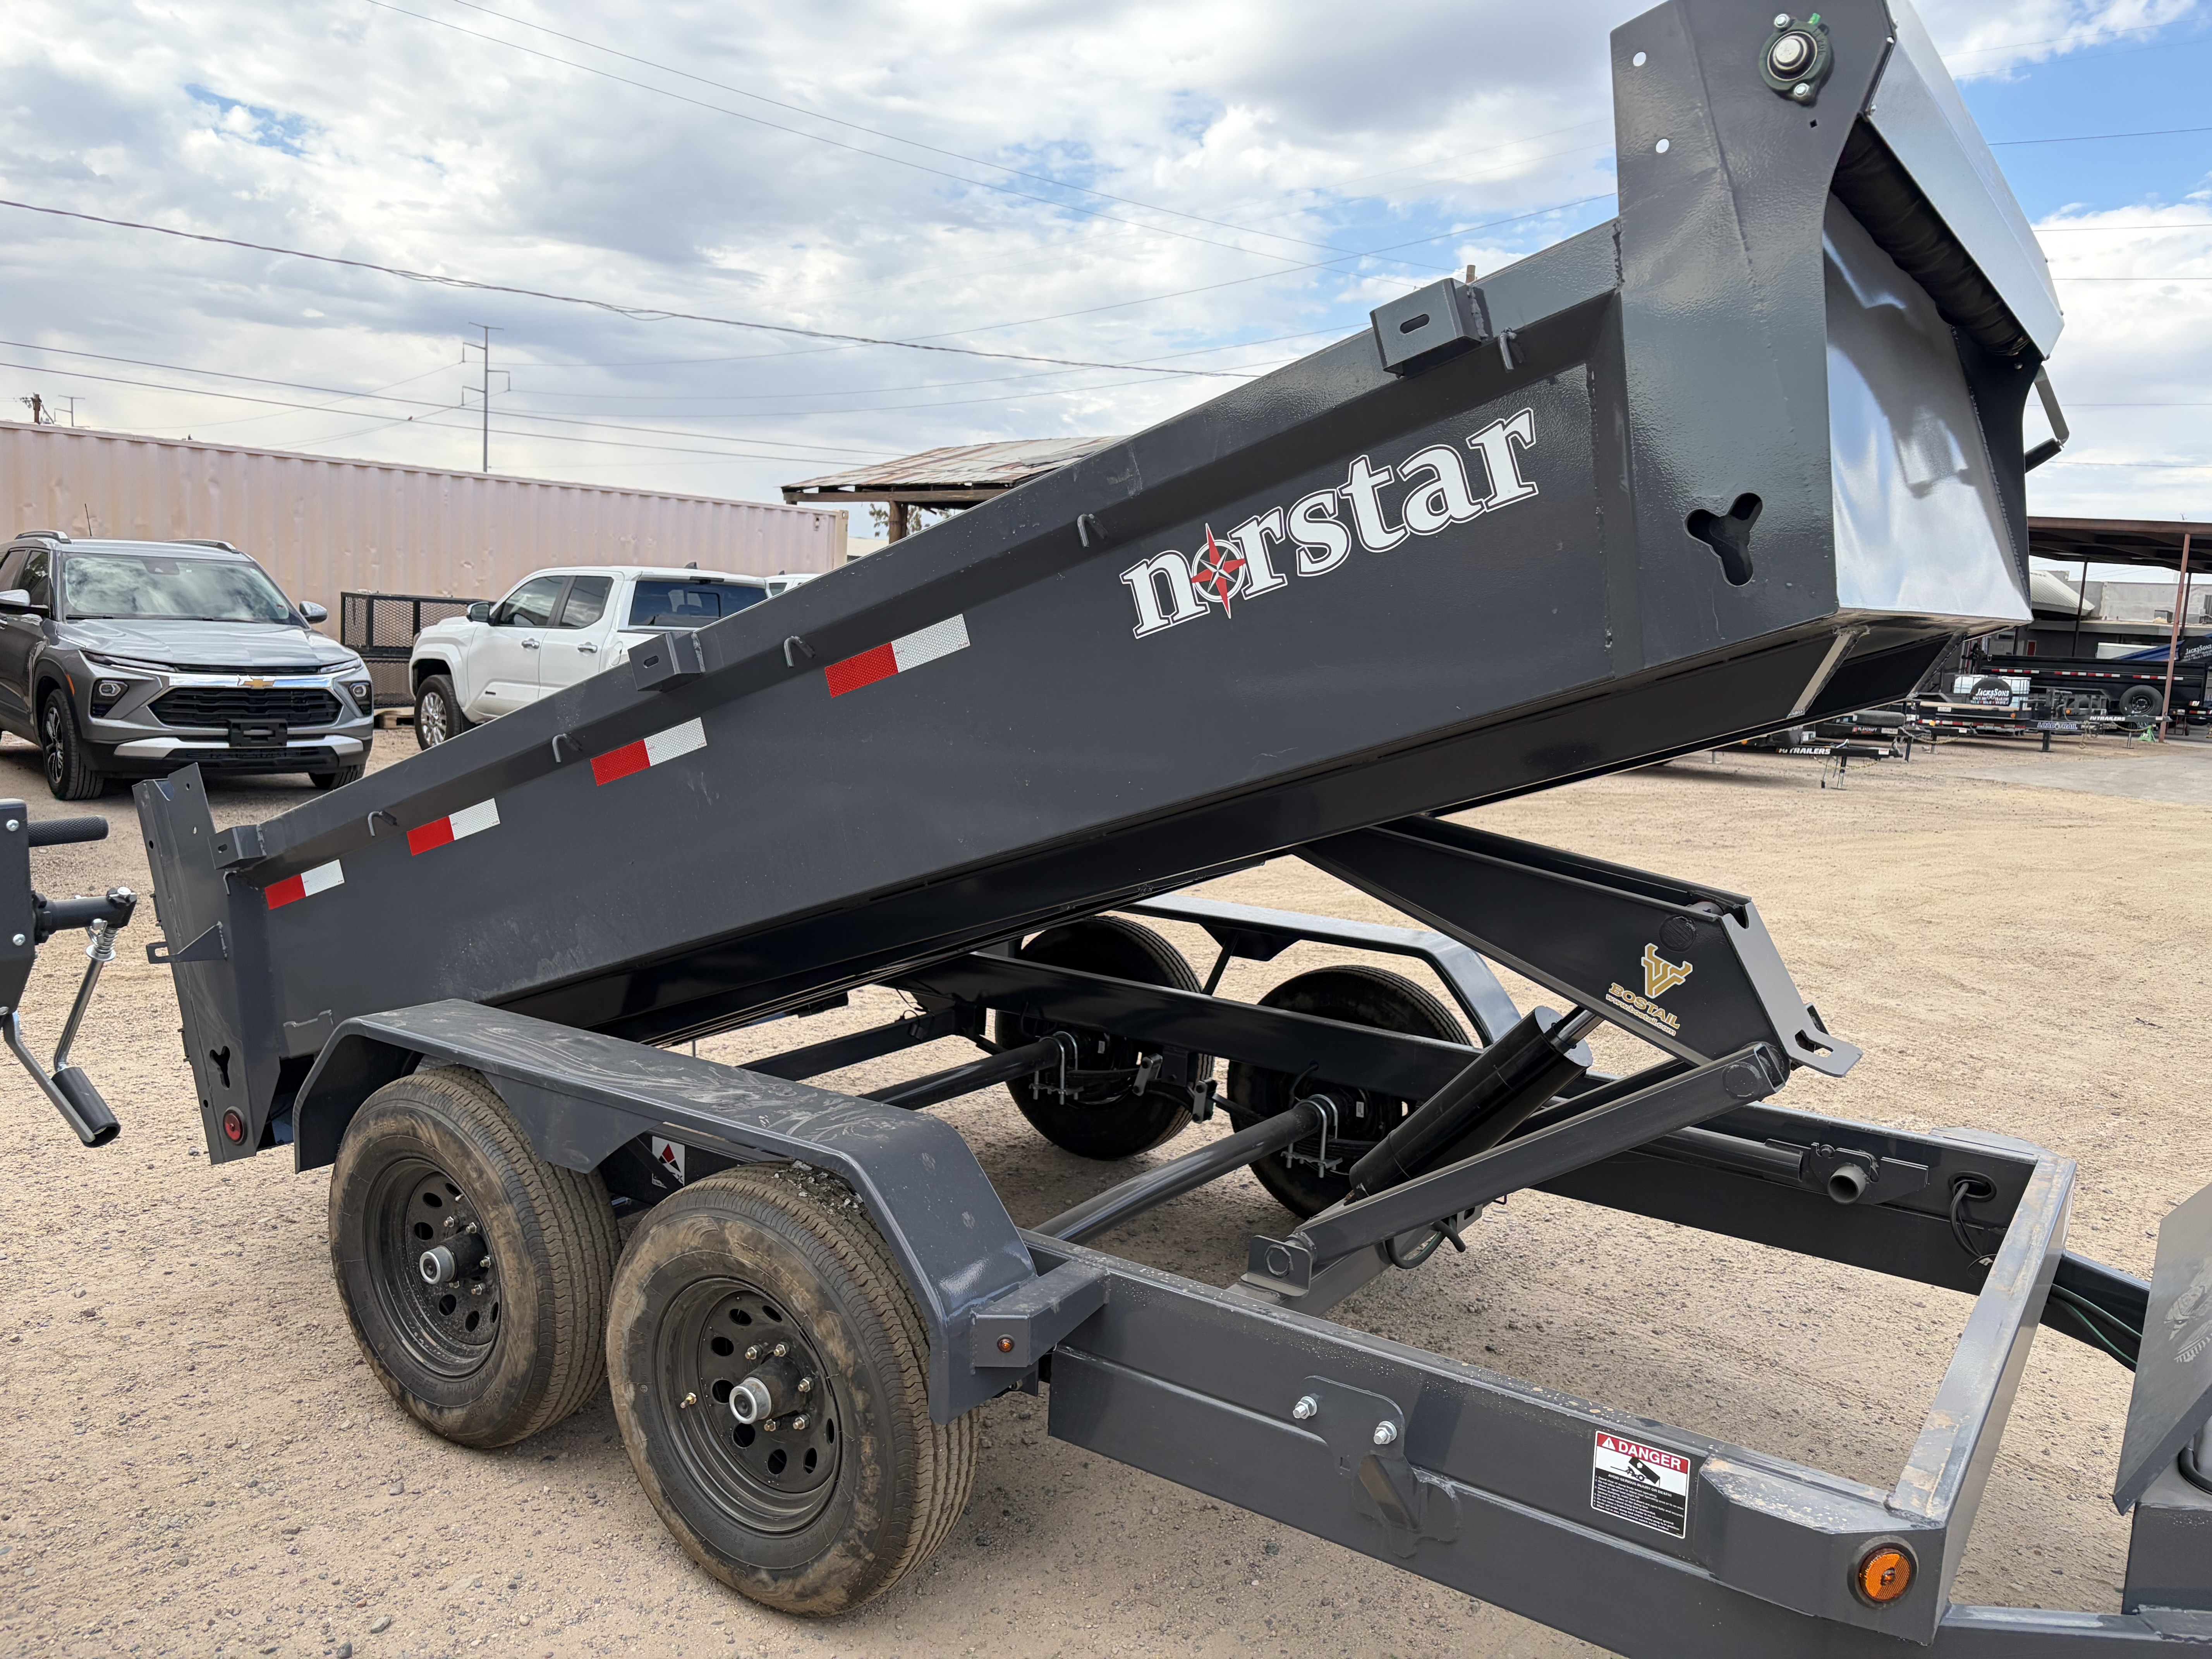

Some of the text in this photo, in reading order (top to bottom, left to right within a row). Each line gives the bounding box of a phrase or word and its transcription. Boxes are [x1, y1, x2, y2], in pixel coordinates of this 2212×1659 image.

[1119, 407, 1539, 639] norstar
[1606, 994, 1676, 1037] www.bostail.com
[1609, 982, 1680, 1029] BOSTAIL
[1618, 1441, 1681, 1470] DANGER
